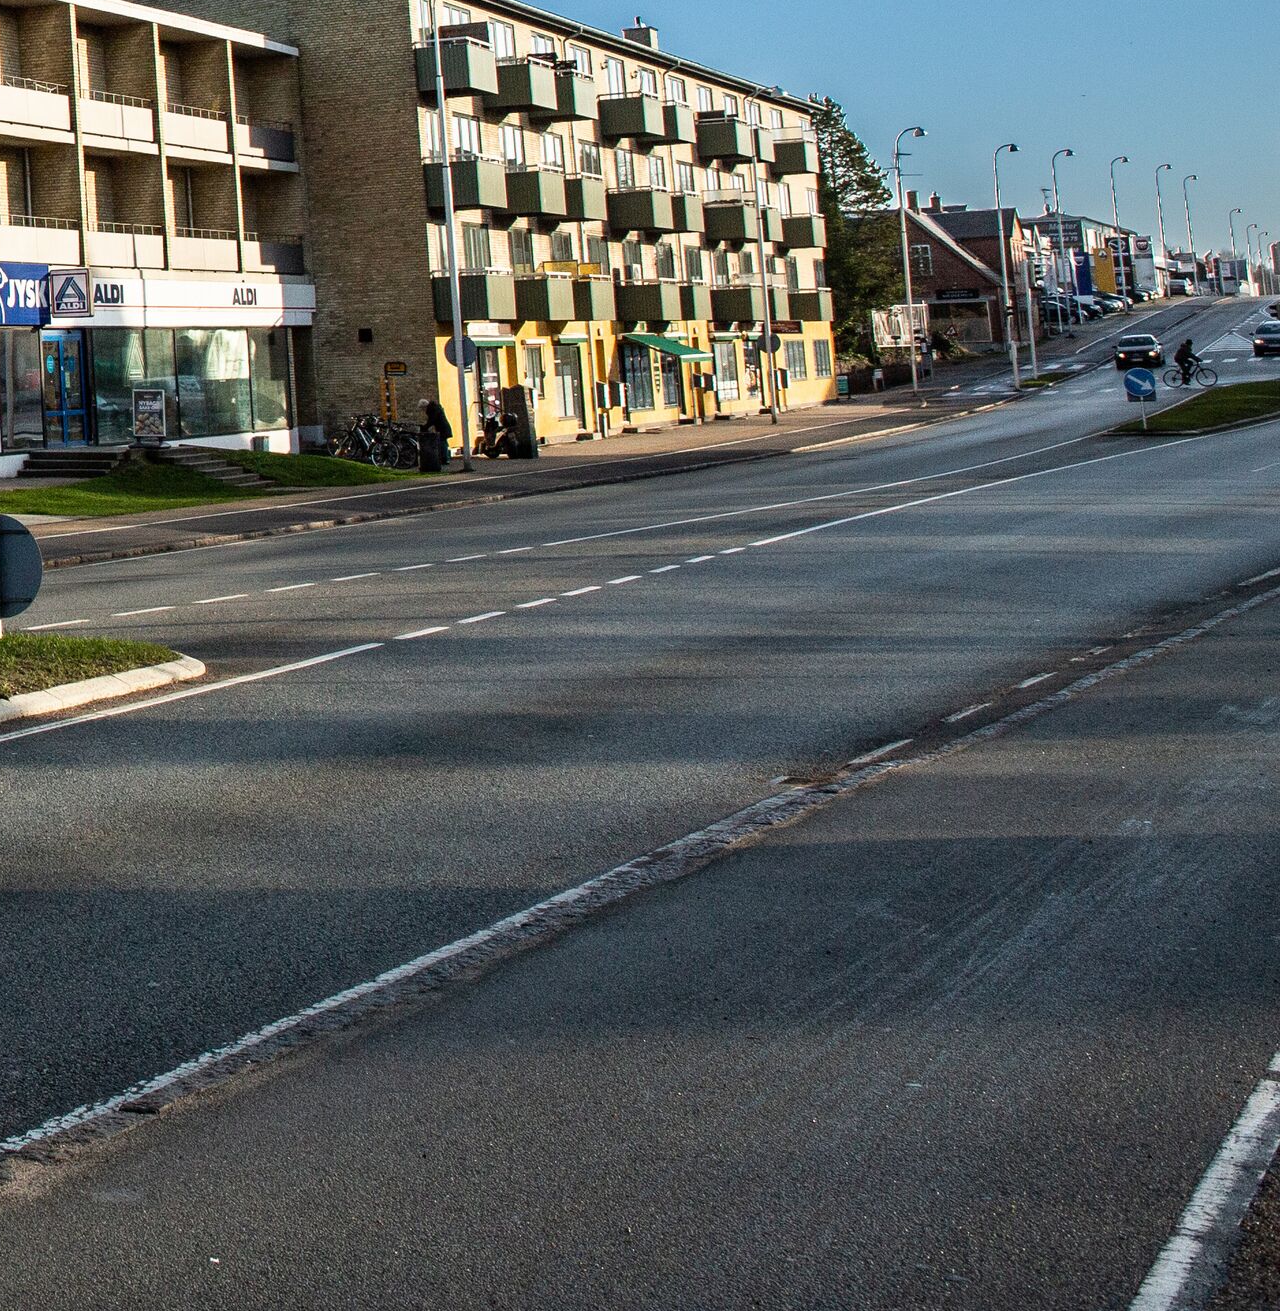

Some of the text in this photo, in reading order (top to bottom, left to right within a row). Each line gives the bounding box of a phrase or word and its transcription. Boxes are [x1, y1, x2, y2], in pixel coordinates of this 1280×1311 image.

[7, 279, 48, 308] JYSK
[94, 284, 124, 304] ALDI
[232, 287, 257, 306] ALDI
[59, 302, 84, 310] ALDI
